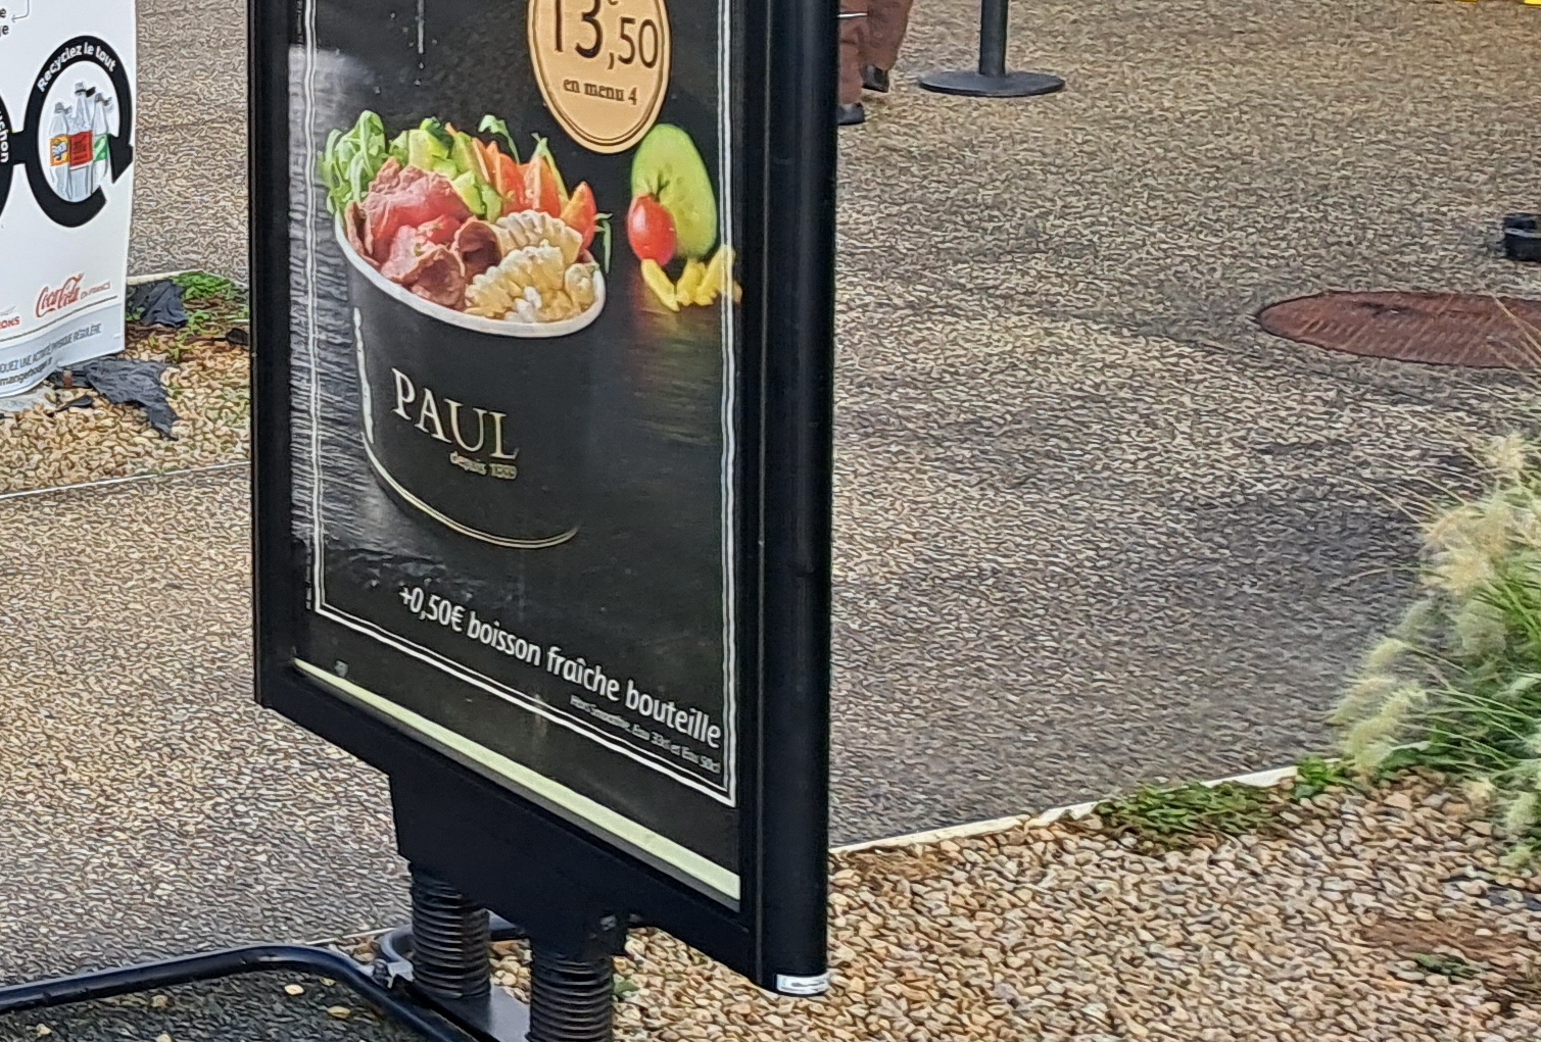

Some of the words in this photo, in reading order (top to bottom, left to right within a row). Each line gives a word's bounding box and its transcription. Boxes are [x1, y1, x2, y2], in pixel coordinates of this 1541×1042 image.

[36, 42, 83, 92] Recyclez
[83, 42, 95, 56] le
[95, 47, 117, 73] tout
[563, 77, 581, 95] en
[584, 81, 626, 103] menu
[627, 85, 638, 106] 4
[391, 367, 519, 459] PAUL
[399, 587, 466, 632] +0,50€
[467, 610, 542, 666] boisson
[546, 645, 621, 702] fraîche
[625, 678, 722, 749] bouteille
